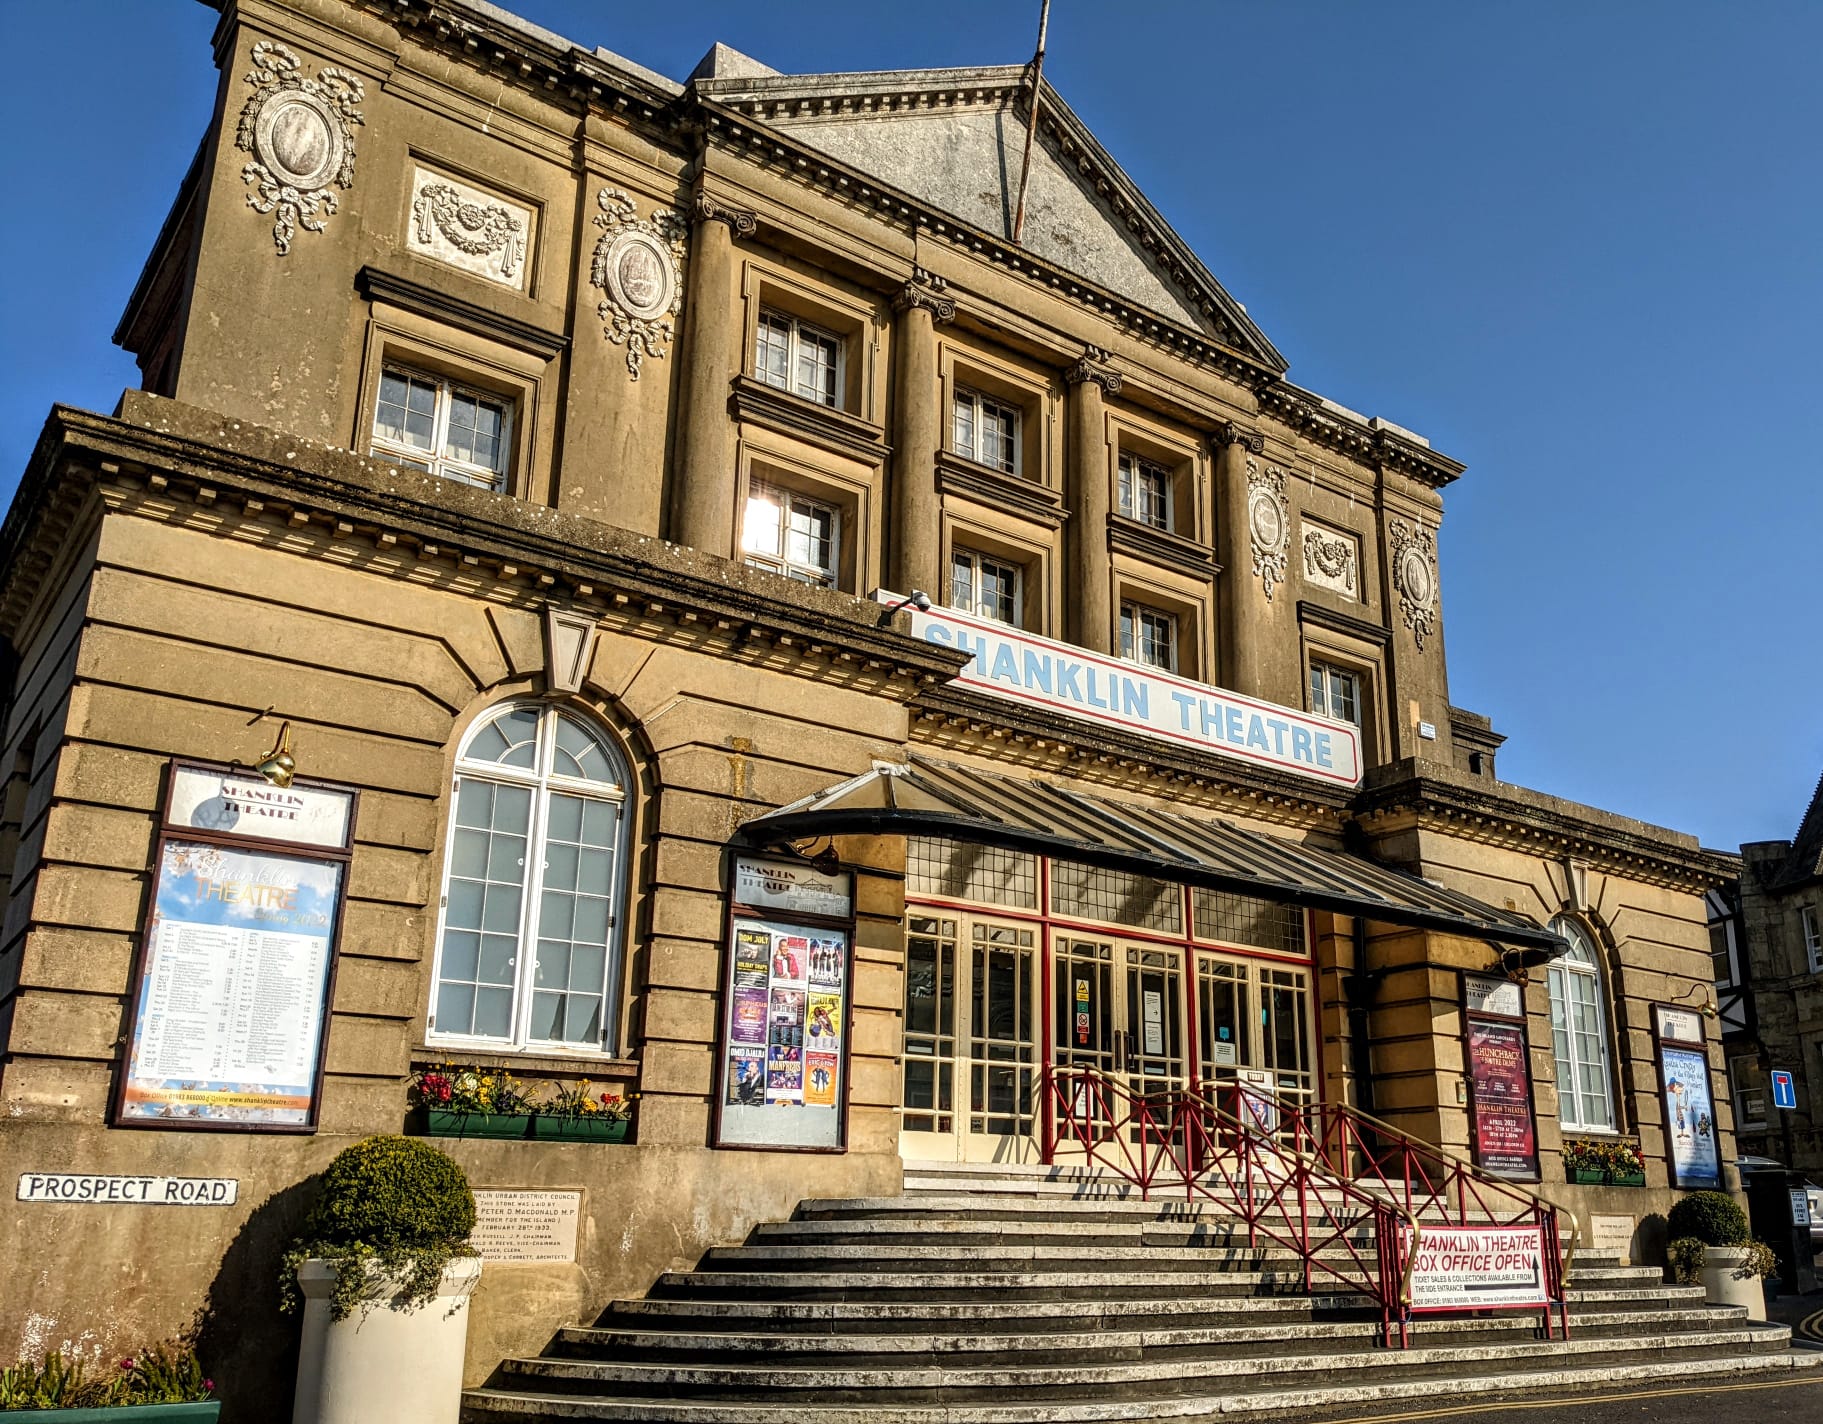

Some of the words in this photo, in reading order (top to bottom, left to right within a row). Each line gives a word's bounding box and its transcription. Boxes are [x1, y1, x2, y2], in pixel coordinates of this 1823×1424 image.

[1171, 691, 1333, 769] THEATRE
[221, 785, 304, 806] SHANKLIN
[224, 801, 299, 820] THEATRE
[194, 876, 298, 911] THEATRE
[1479, 1047, 1521, 1061] HUNCHBACK
[1504, 1105, 1526, 1115] THEATRE
[30, 1177, 153, 1199] PROSPECT
[165, 1181, 227, 1201] ROAD
[1481, 1233, 1539, 1252] THEATRE
[1413, 1254, 1439, 1272] BOX
[1441, 1253, 1493, 1271] OFFICE
[1494, 1253, 1532, 1271] OPEN
[1415, 1275, 1430, 1283] TICKET
[1430, 1275, 1447, 1283] SALES
[1452, 1274, 1487, 1283] COLLECTIONS
[1516, 1273, 1533, 1281] FROM
[1415, 1285, 1425, 1293] THE
[1437, 1284, 1464, 1292] ENTRANCE
